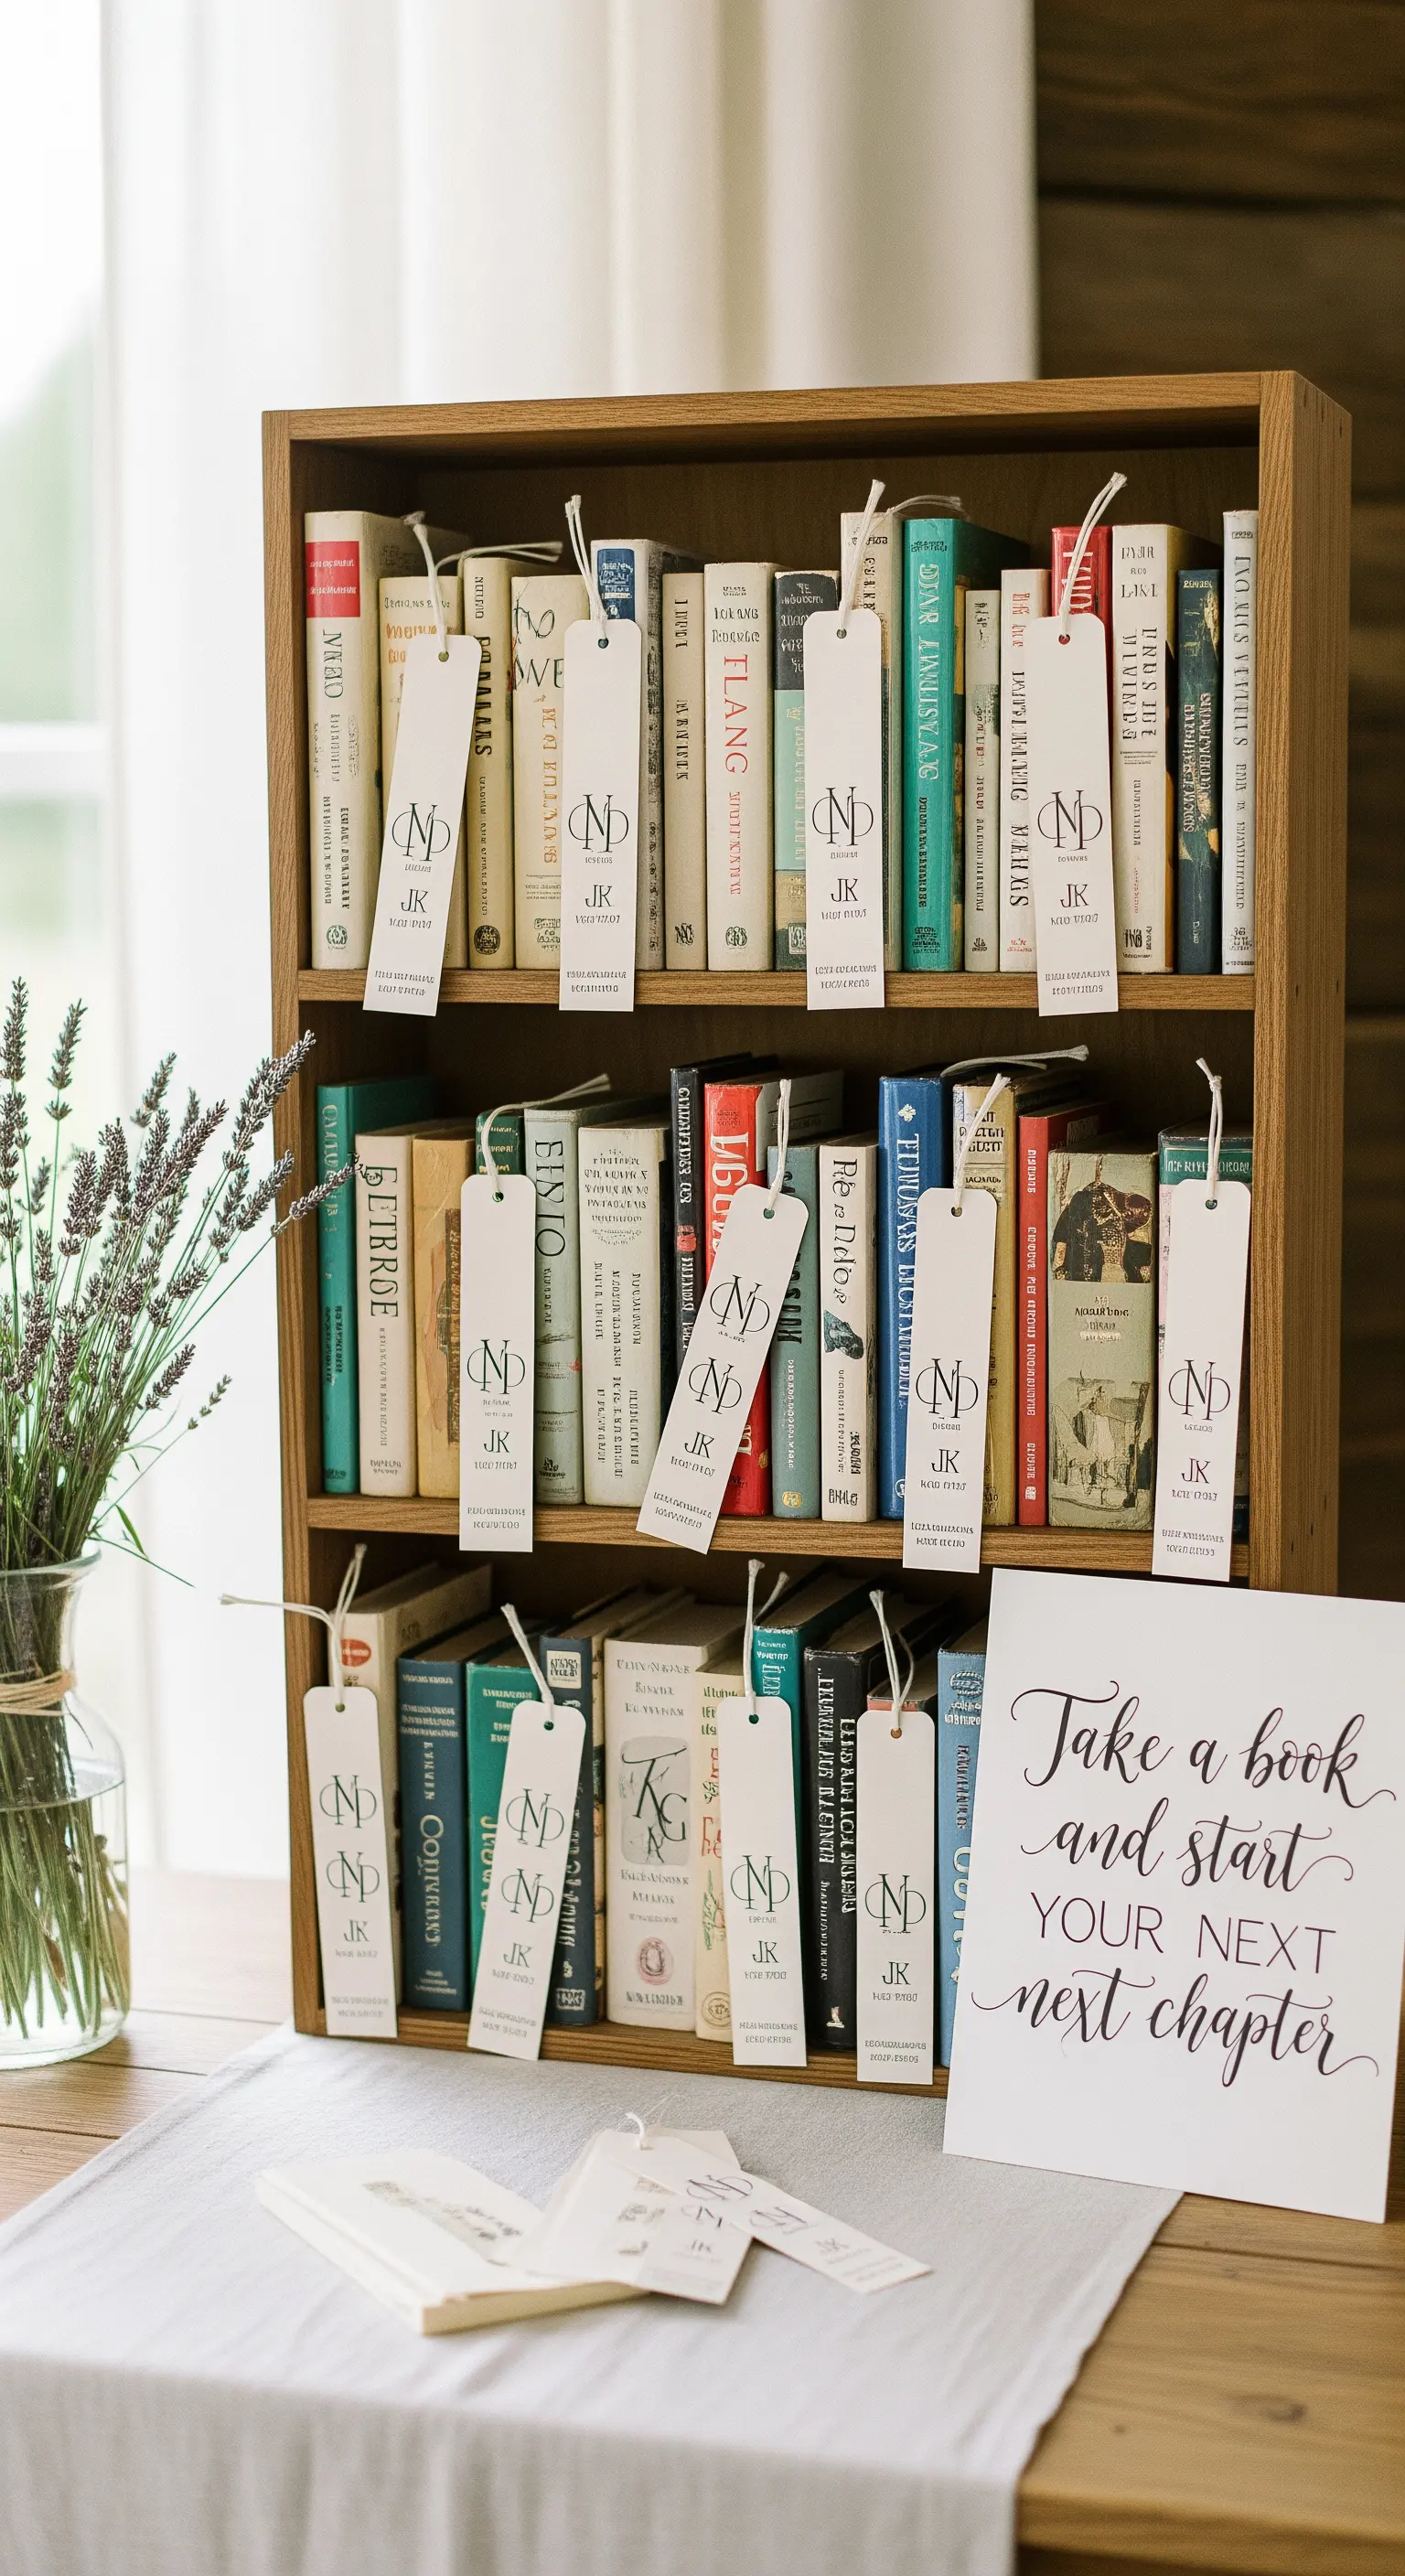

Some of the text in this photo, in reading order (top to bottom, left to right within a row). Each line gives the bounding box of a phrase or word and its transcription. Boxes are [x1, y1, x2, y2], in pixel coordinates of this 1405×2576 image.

[401, 889, 428, 913] JK
[585, 885, 612, 907] JK
[831, 878, 858, 902] JK
[1060, 884, 1089, 907] JK
[484, 1430, 509, 1453] JK
[684, 1432, 714, 1458] JK
[931, 1449, 960, 1473] JK
[1181, 1457, 1210, 1484] JK
[1011, 1680, 1174, 1787] Take
[1190, 1740, 1228, 1784] a
[1241, 1708, 1396, 1809] book
[1021, 1798, 1353, 1892] and start
[344, 1920, 369, 1941] JK
[1031, 1893, 1336, 1974] YOUR NEXT
[504, 1943, 531, 1968] JK
[752, 1940, 779, 1963] JK
[882, 1961, 911, 1985] JK
[971, 1967, 1378, 2088] next chapter
